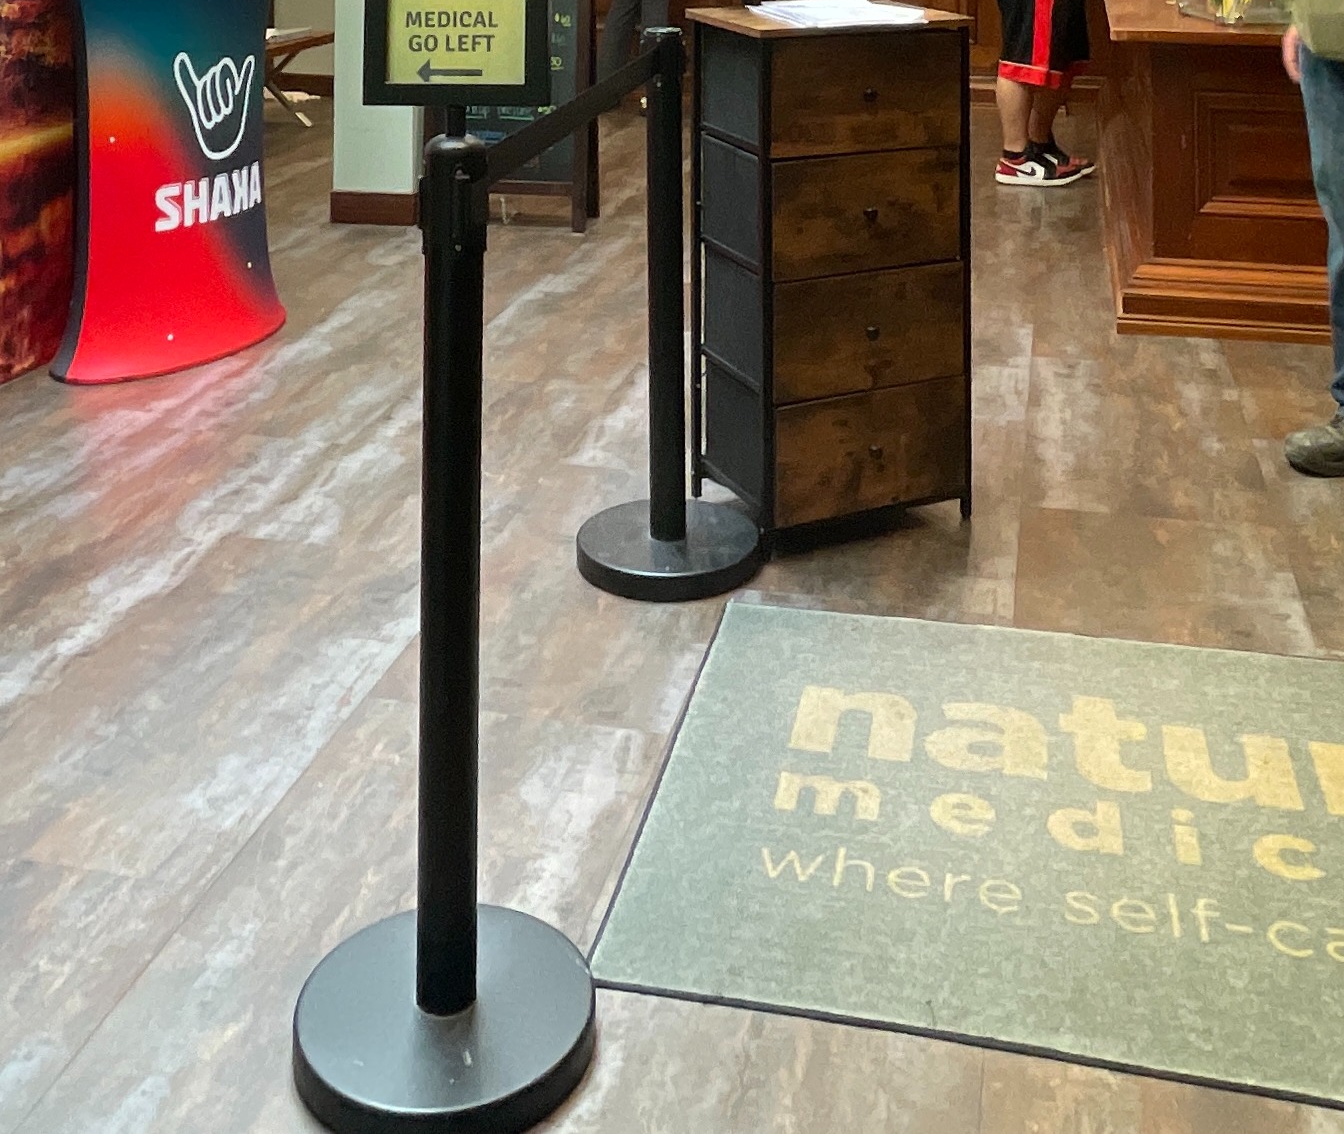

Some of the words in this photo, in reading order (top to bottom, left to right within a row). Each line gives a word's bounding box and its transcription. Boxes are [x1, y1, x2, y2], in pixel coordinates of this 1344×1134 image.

[405, 10, 499, 28] MEDICAL
[408, 34, 439, 53] GO
[445, 34, 496, 53] LEFT
[155, 161, 262, 232] SHAKA
[761, 847, 1022, 916] where
